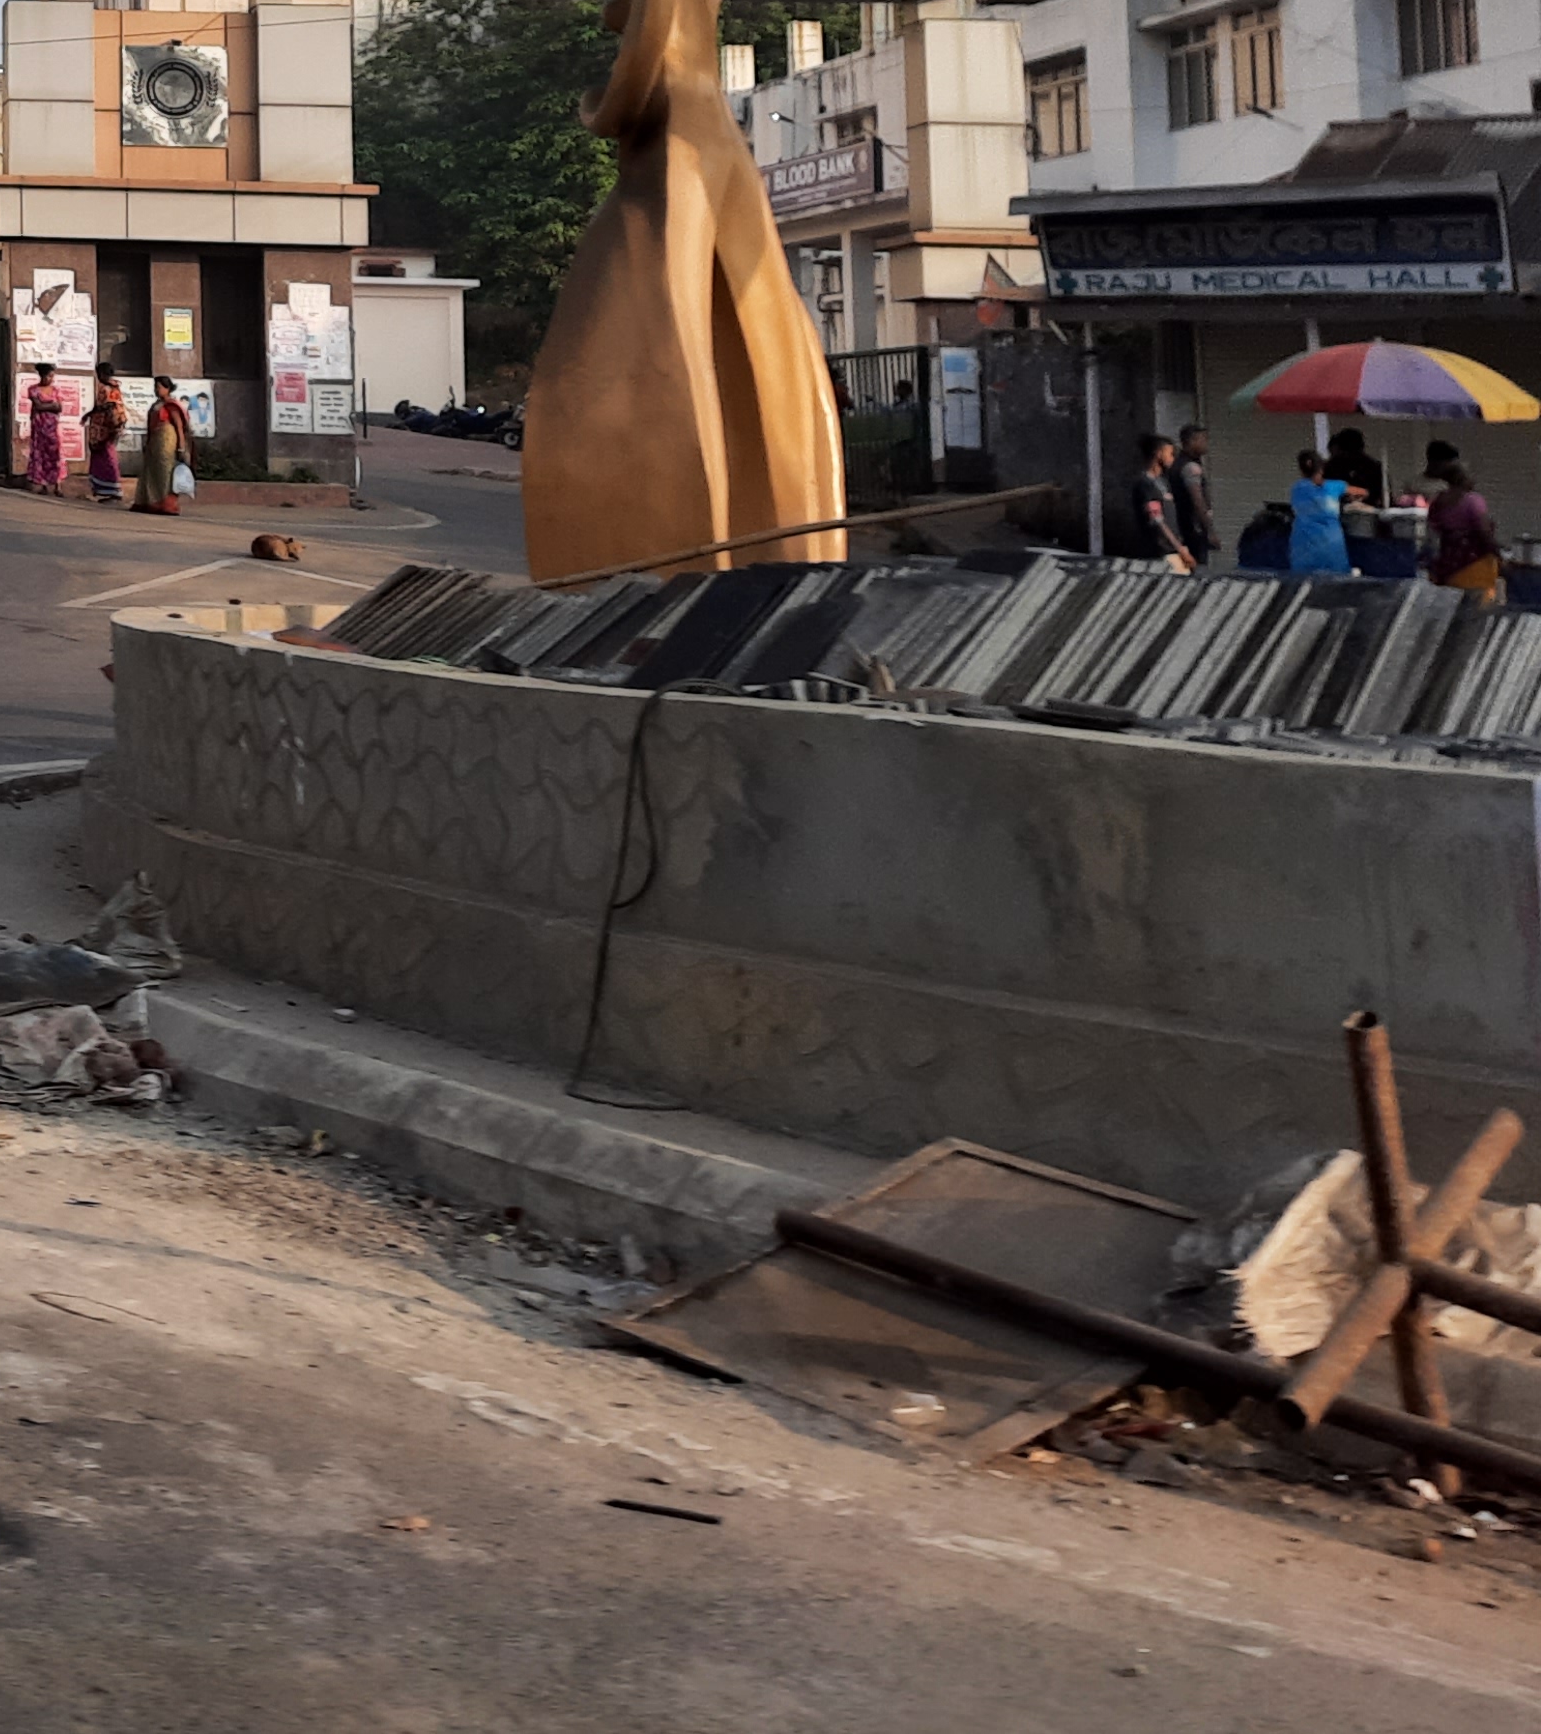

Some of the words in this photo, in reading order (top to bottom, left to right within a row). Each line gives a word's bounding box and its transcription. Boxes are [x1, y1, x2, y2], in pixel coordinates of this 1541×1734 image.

[773, 161, 816, 192] BLOOD
[818, 152, 855, 181] BANK
[1084, 272, 1172, 291] RAJU
[1192, 270, 1348, 292] MEDICAL
[1369, 267, 1468, 289] HALL
